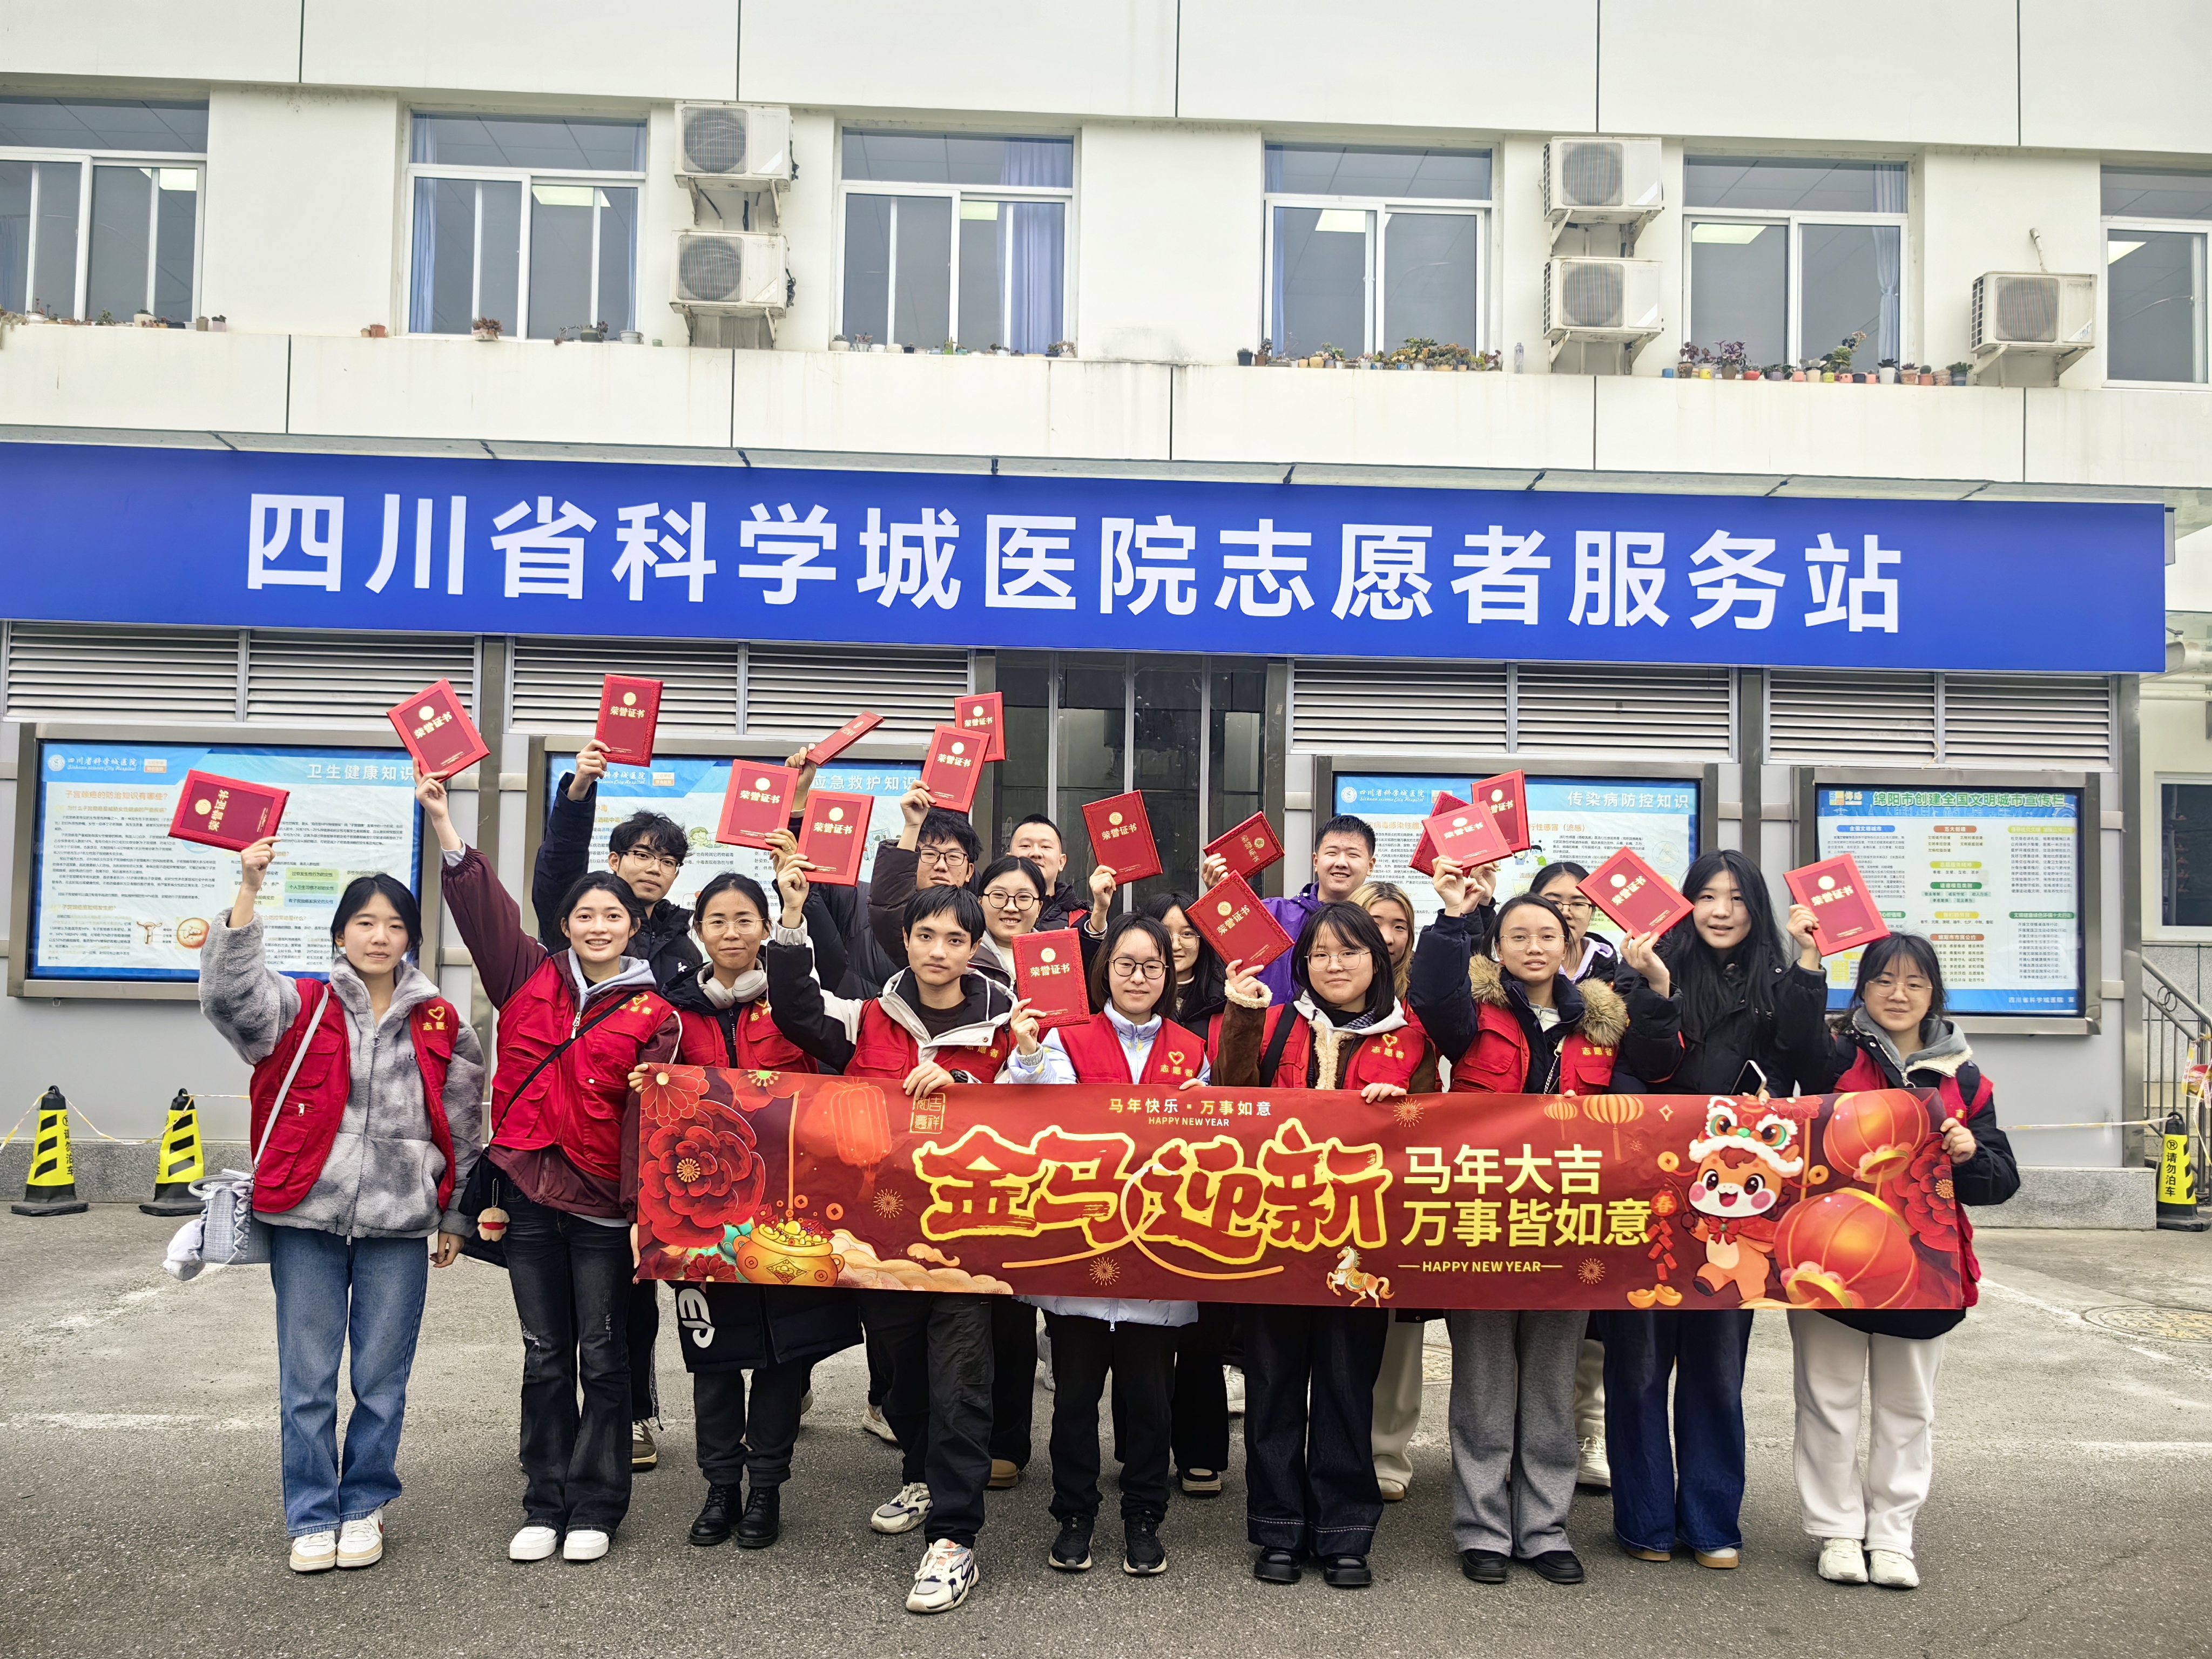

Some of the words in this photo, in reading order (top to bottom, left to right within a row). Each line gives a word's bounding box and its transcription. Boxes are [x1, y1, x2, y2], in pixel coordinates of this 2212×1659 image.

[247, 492, 1902, 633] 四川省科学城医院志愿者服务站
[609, 705, 646, 719] 荣誉证书
[413, 711, 453, 740] 荣誉证书
[964, 716, 993, 727] 荣誉证书
[67, 757, 137, 767] 四川省科学城医院
[937, 753, 972, 767] 荣誉证书
[307, 763, 415, 782] 卫生健康知识
[811, 774, 918, 791] 应急救护知识
[739, 790, 781, 804] 荣誉证书
[1359, 788, 1425, 797] 四川省科学城医院
[1568, 791, 1689, 810] 传染病防控知识
[1872, 791, 2066, 808] 绵阳市创建全国文明城市宣传栏
[208, 789, 230, 832] 荣誉证书
[813, 821, 854, 835] 荣誉证书
[1101, 822, 1137, 841] 荣誉证书
[1443, 821, 1483, 839] 荣誉证书
[1240, 835, 1260, 862] 荣誉证书
[1611, 875, 1647, 906] 荣誉证书
[1810, 885, 1854, 906] 荣誉证书
[1216, 904, 1250, 936] 荣誉证书
[1029, 962, 1070, 977] 荣誉证书
[1371, 1046, 1405, 1059] 志愿者
[1159, 1064, 1194, 1078] 志愿者
[1148, 1116, 1180, 1125] HAPPY
[1182, 1117, 1205, 1126] NEW
[1205, 1118, 1230, 1127] YEAR
[1403, 1143, 1603, 1195] 马年大吉
[2164, 1152, 2177, 1197] 请勿泊车
[912, 1117, 1392, 1265] 金马迎新
[1654, 1195, 1674, 1213] 春
[1401, 1197, 1652, 1248] 万事皆如意
[1422, 1260, 1469, 1272] HAPPY
[1472, 1260, 1503, 1272] NEW
[1506, 1260, 1541, 1272] YEAR
